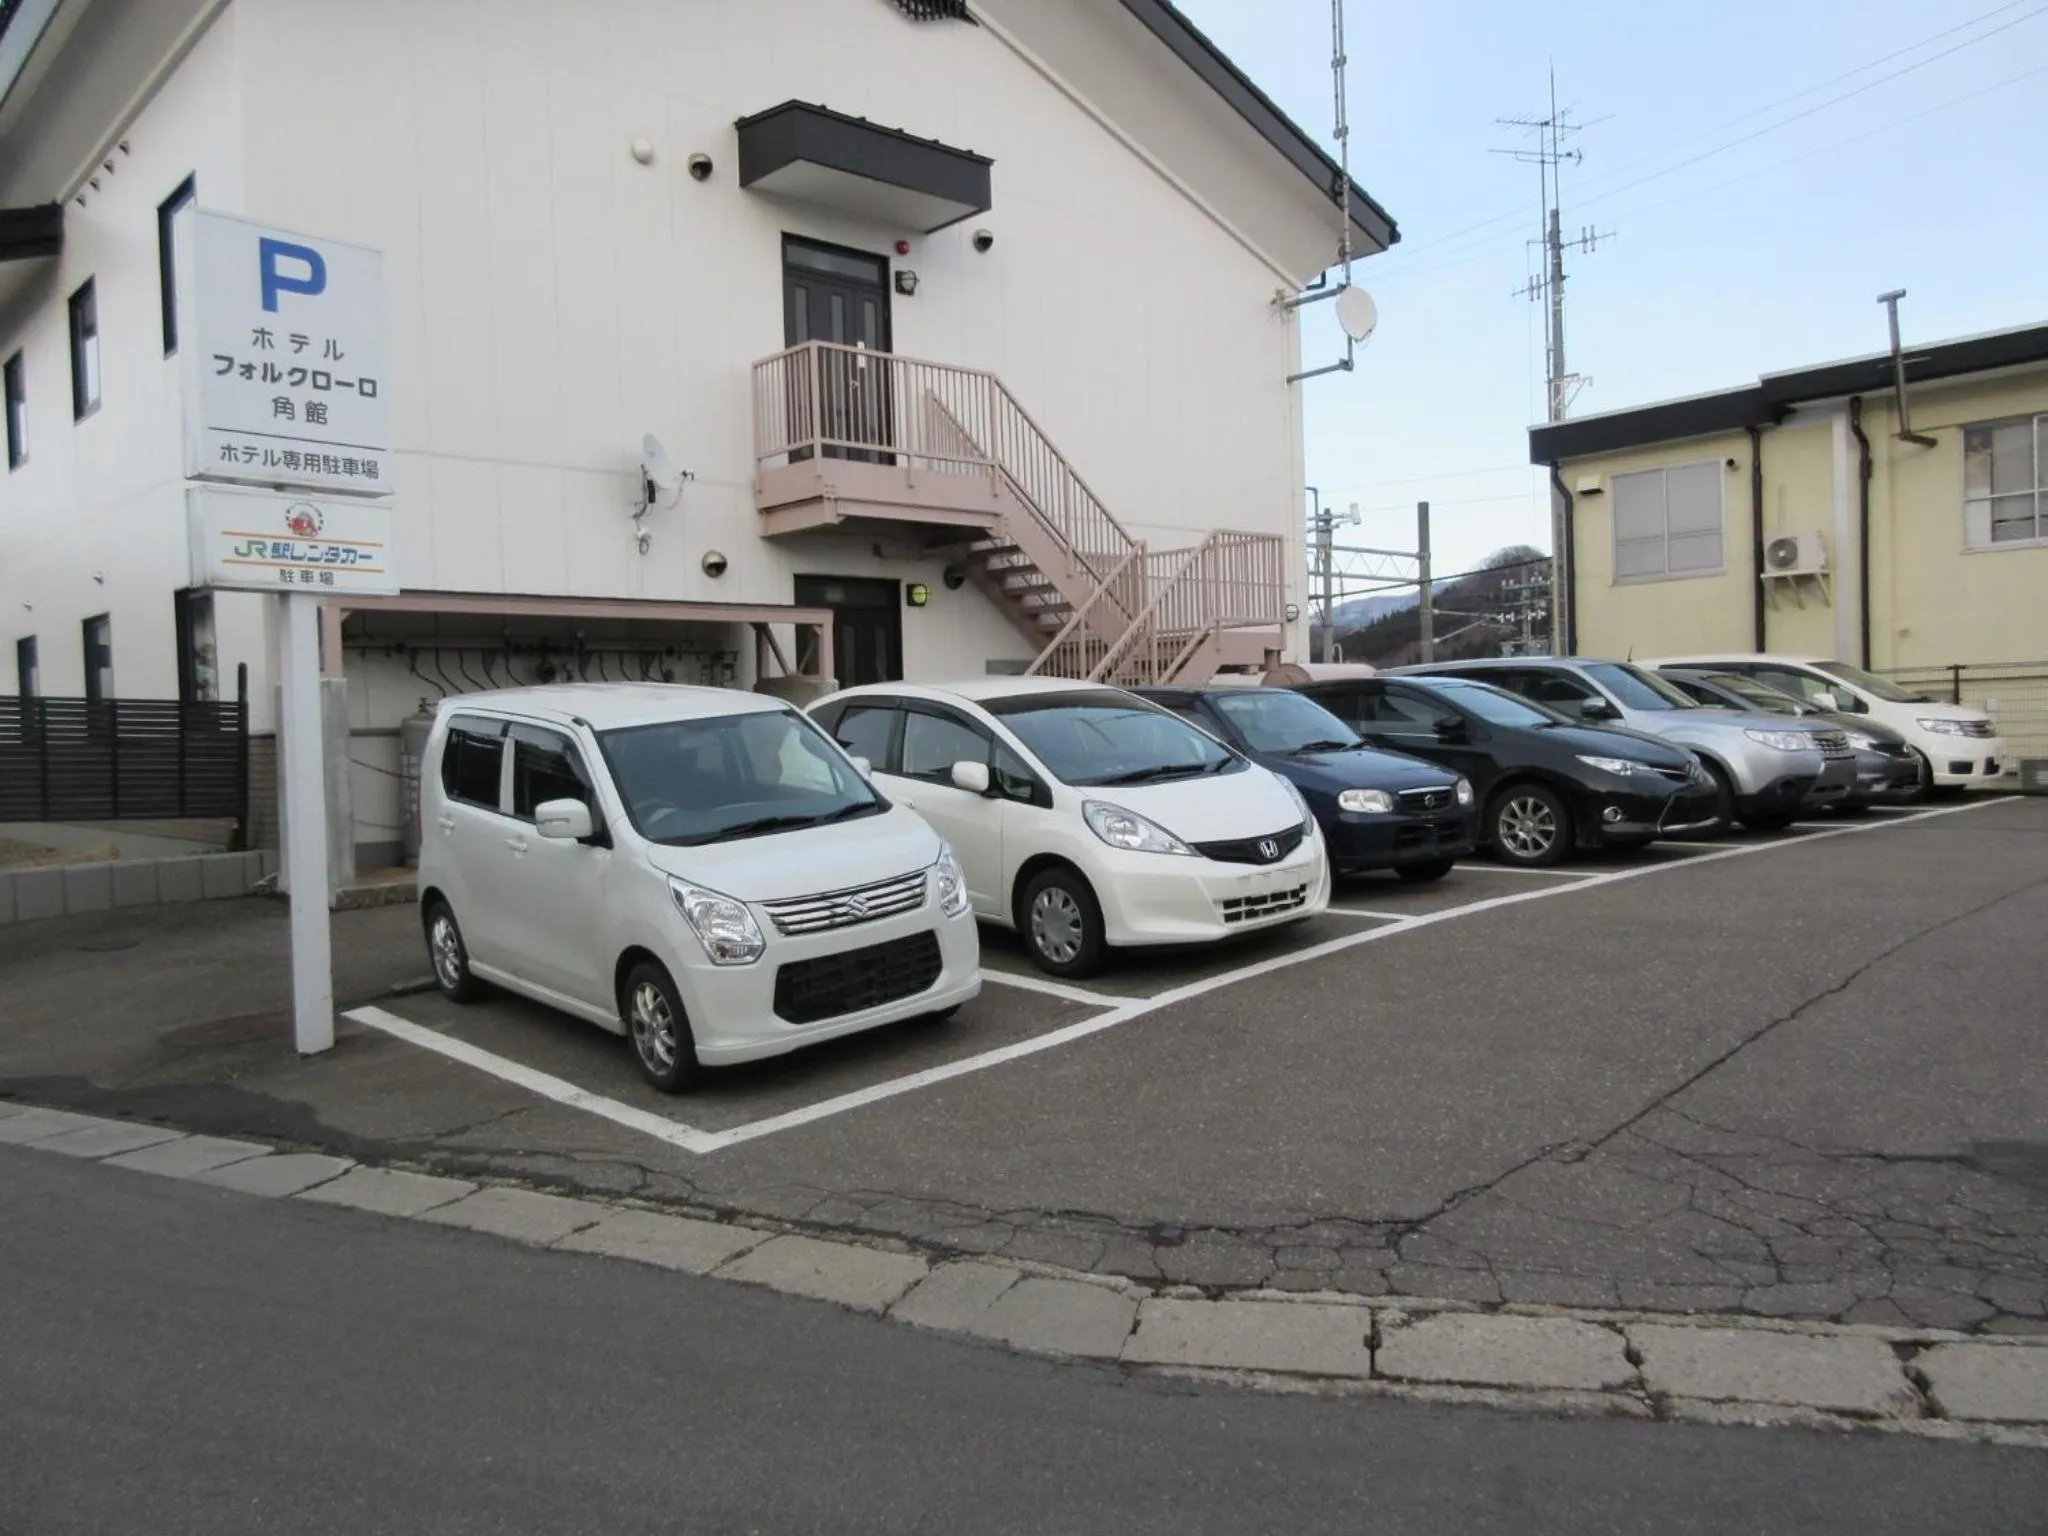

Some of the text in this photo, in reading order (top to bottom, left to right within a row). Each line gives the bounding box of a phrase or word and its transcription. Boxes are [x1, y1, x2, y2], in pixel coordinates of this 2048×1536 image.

[259, 236, 327, 313] P
[251, 327, 345, 362] ホテル
[213, 354, 378, 399] フォルクローロ
[272, 396, 329, 426] 角館
[220, 443, 380, 480] ホテル専用駐車場
[234, 540, 267, 559] JR
[279, 568, 334, 586] 駐車場
